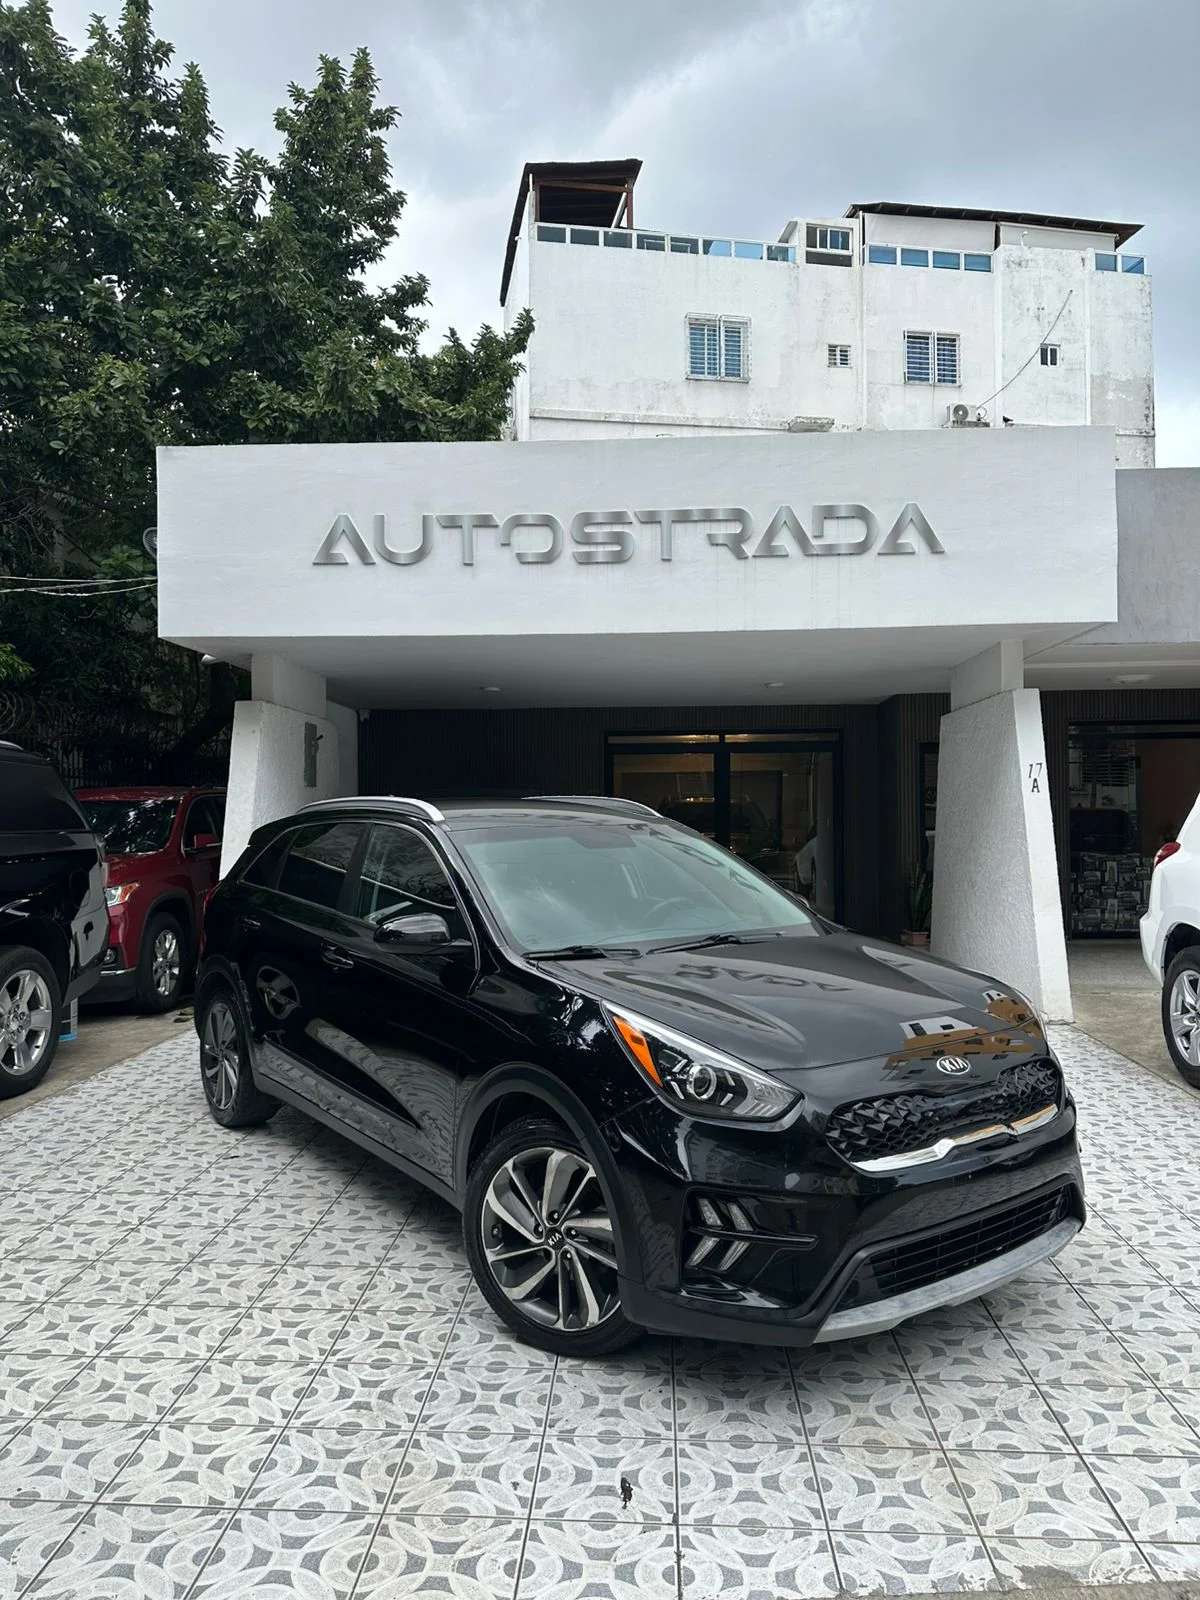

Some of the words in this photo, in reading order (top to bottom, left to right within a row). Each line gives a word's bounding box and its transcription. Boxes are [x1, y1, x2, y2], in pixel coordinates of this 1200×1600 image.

[313, 502, 946, 566] AUTOSTRADA
[1028, 762, 1043, 778] 17
[1031, 777, 1040, 793] A
[938, 1056, 969, 1073] KIA
[547, 1232, 562, 1246] KIA
